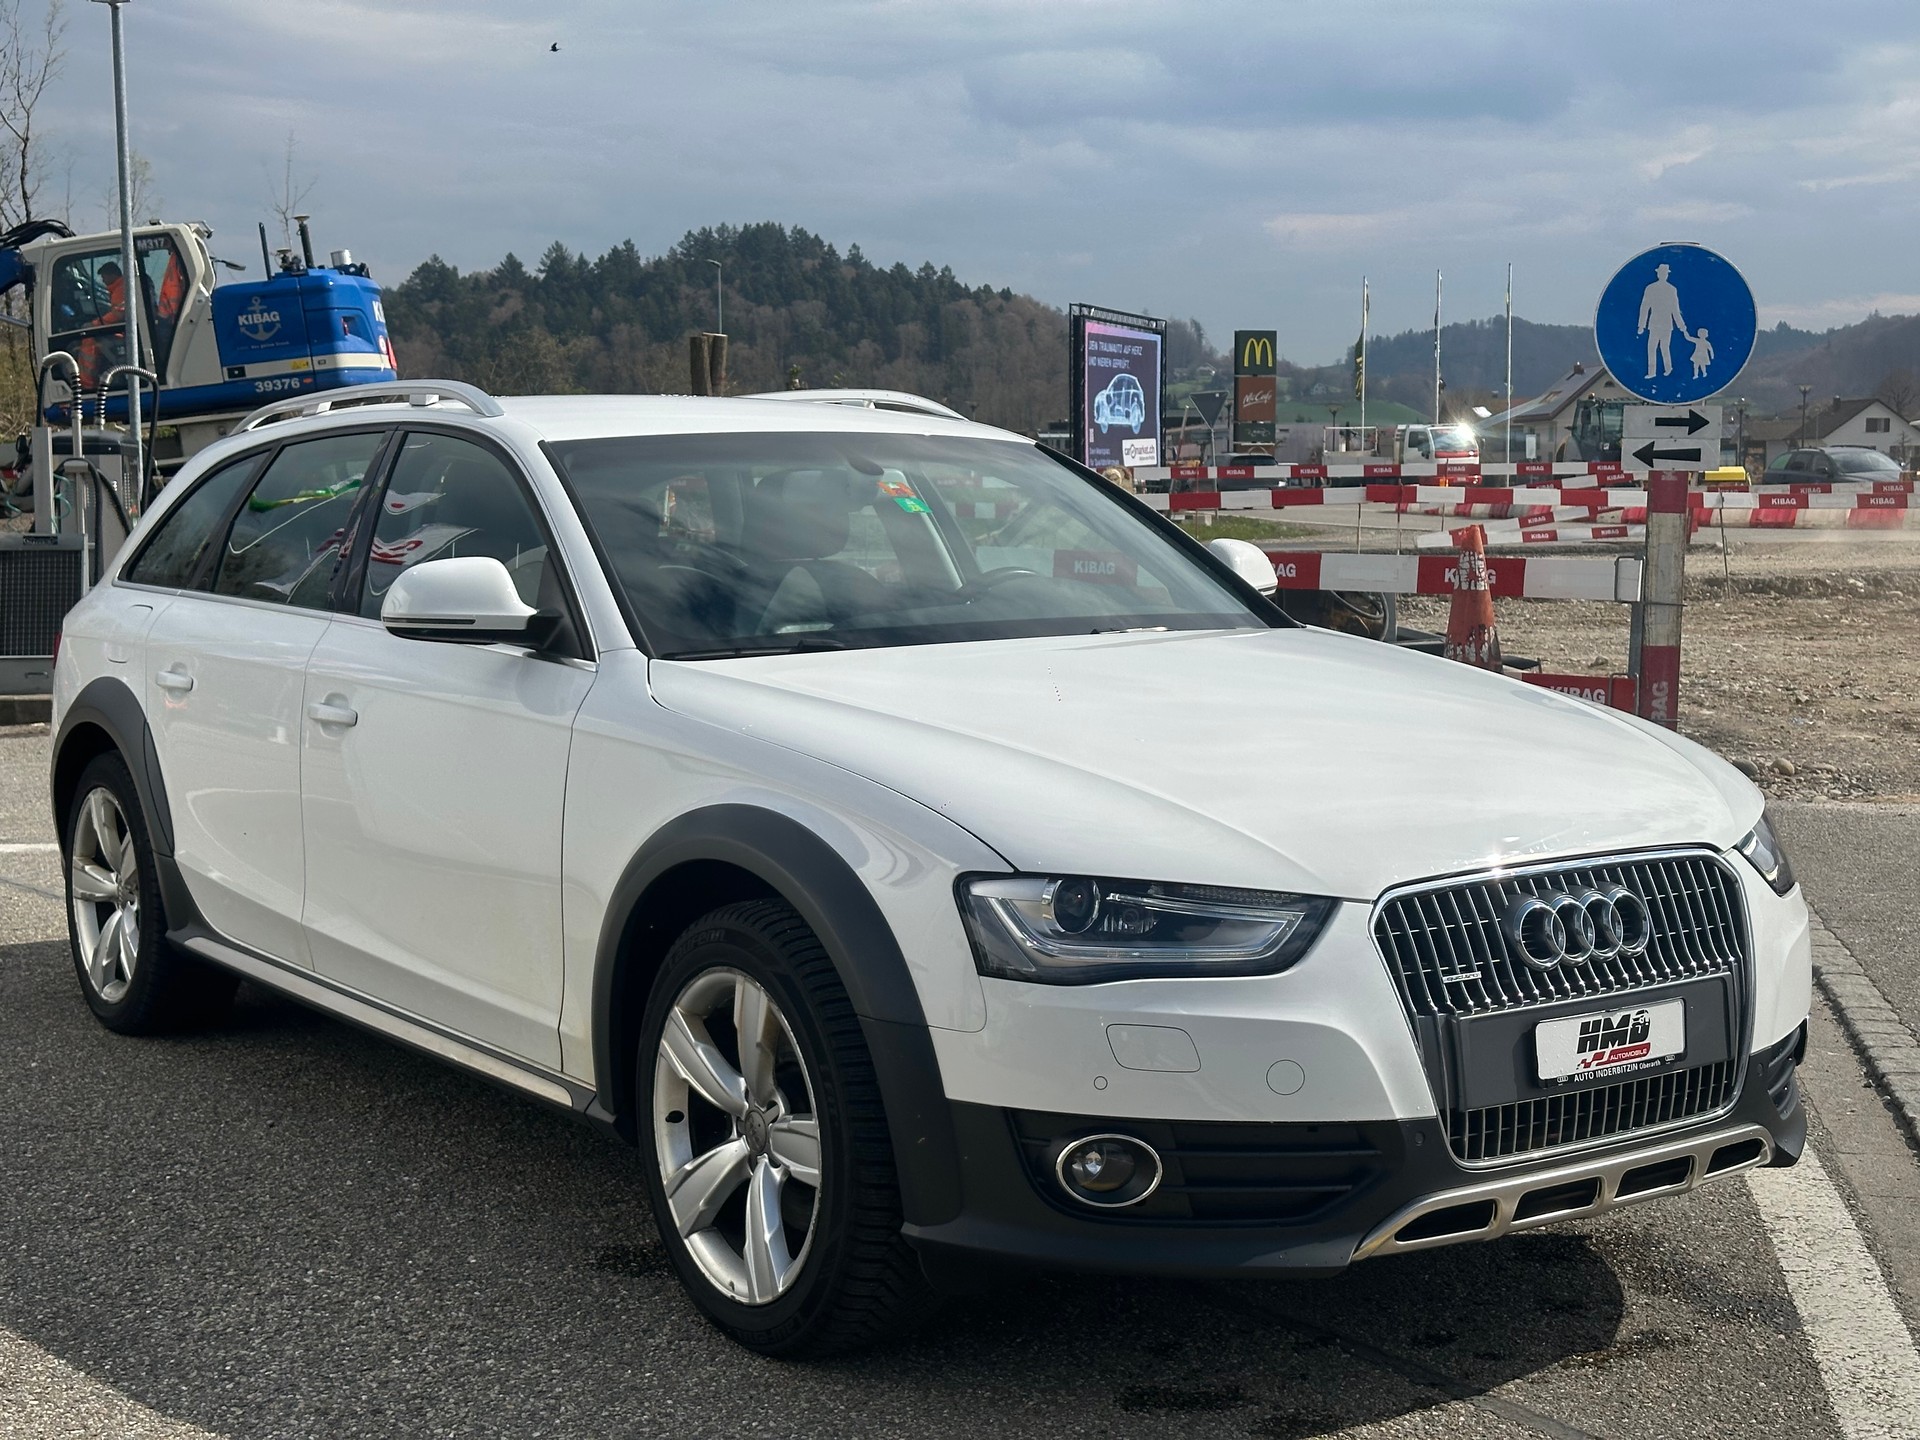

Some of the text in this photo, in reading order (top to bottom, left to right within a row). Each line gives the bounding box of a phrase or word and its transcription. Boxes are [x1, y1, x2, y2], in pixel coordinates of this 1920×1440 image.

[137, 237, 165, 250] M317
[238, 311, 280, 326] KIBAG
[254, 377, 300, 393] 39376
[1771, 497, 1797, 505] KIBAG
[1870, 497, 1896, 505] KIBAG
[1527, 516, 1546, 524] KIBAG
[1074, 560, 1116, 575] KIBAG
[1577, 1010, 1651, 1054] HMD
[1609, 1048, 1648, 1061] AUTOMOBILE
[1574, 1060, 1661, 1083] AUTO INDERBITZIN Oberarth
